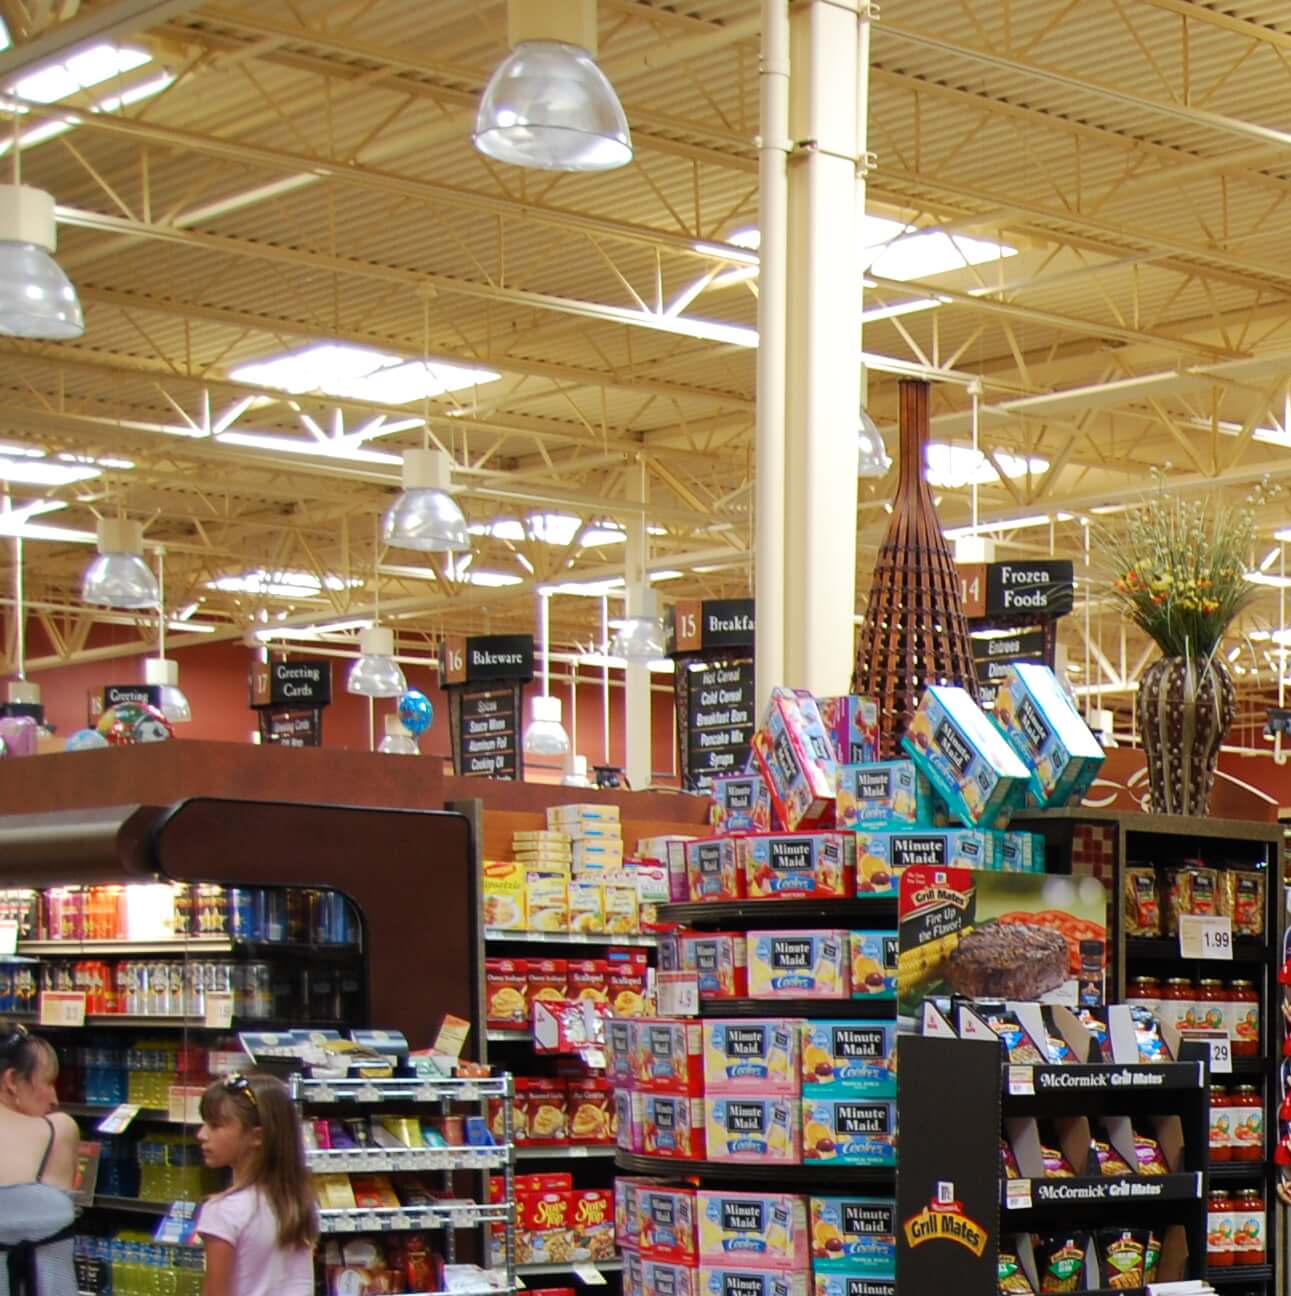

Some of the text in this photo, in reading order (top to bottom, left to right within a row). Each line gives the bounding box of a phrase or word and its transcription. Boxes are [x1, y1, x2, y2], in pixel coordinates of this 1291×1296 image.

[1002, 567, 1049, 584] Frozen
[961, 577, 979, 603] 14
[1004, 590, 1048, 608] Foods
[680, 614, 697, 639] 15
[448, 650, 524, 671] 16 Bakeware
[277, 665, 320, 681] Greeting
[283, 683, 313, 698] Cards
[859, 774, 889, 784] Minute
[773, 844, 810, 854] Minute
[895, 840, 943, 853] Minute
[915, 889, 965, 906] Grill Mates
[926, 906, 957, 928] Fire Up
[919, 917, 962, 943] the Flavor!
[1204, 931, 1229, 947] 1.99
[775, 941, 810, 954] Minute
[837, 1031, 881, 1044] Minute
[1041, 1069, 1163, 1087] McCormick Grill Mates
[839, 1107, 886, 1120] Minute
[1039, 1181, 1162, 1199] McCormick Grill Mates
[846, 1208, 891, 1220] Minute
[911, 1213, 981, 1247] Grill Mates
[851, 1284, 895, 1296] Minute
